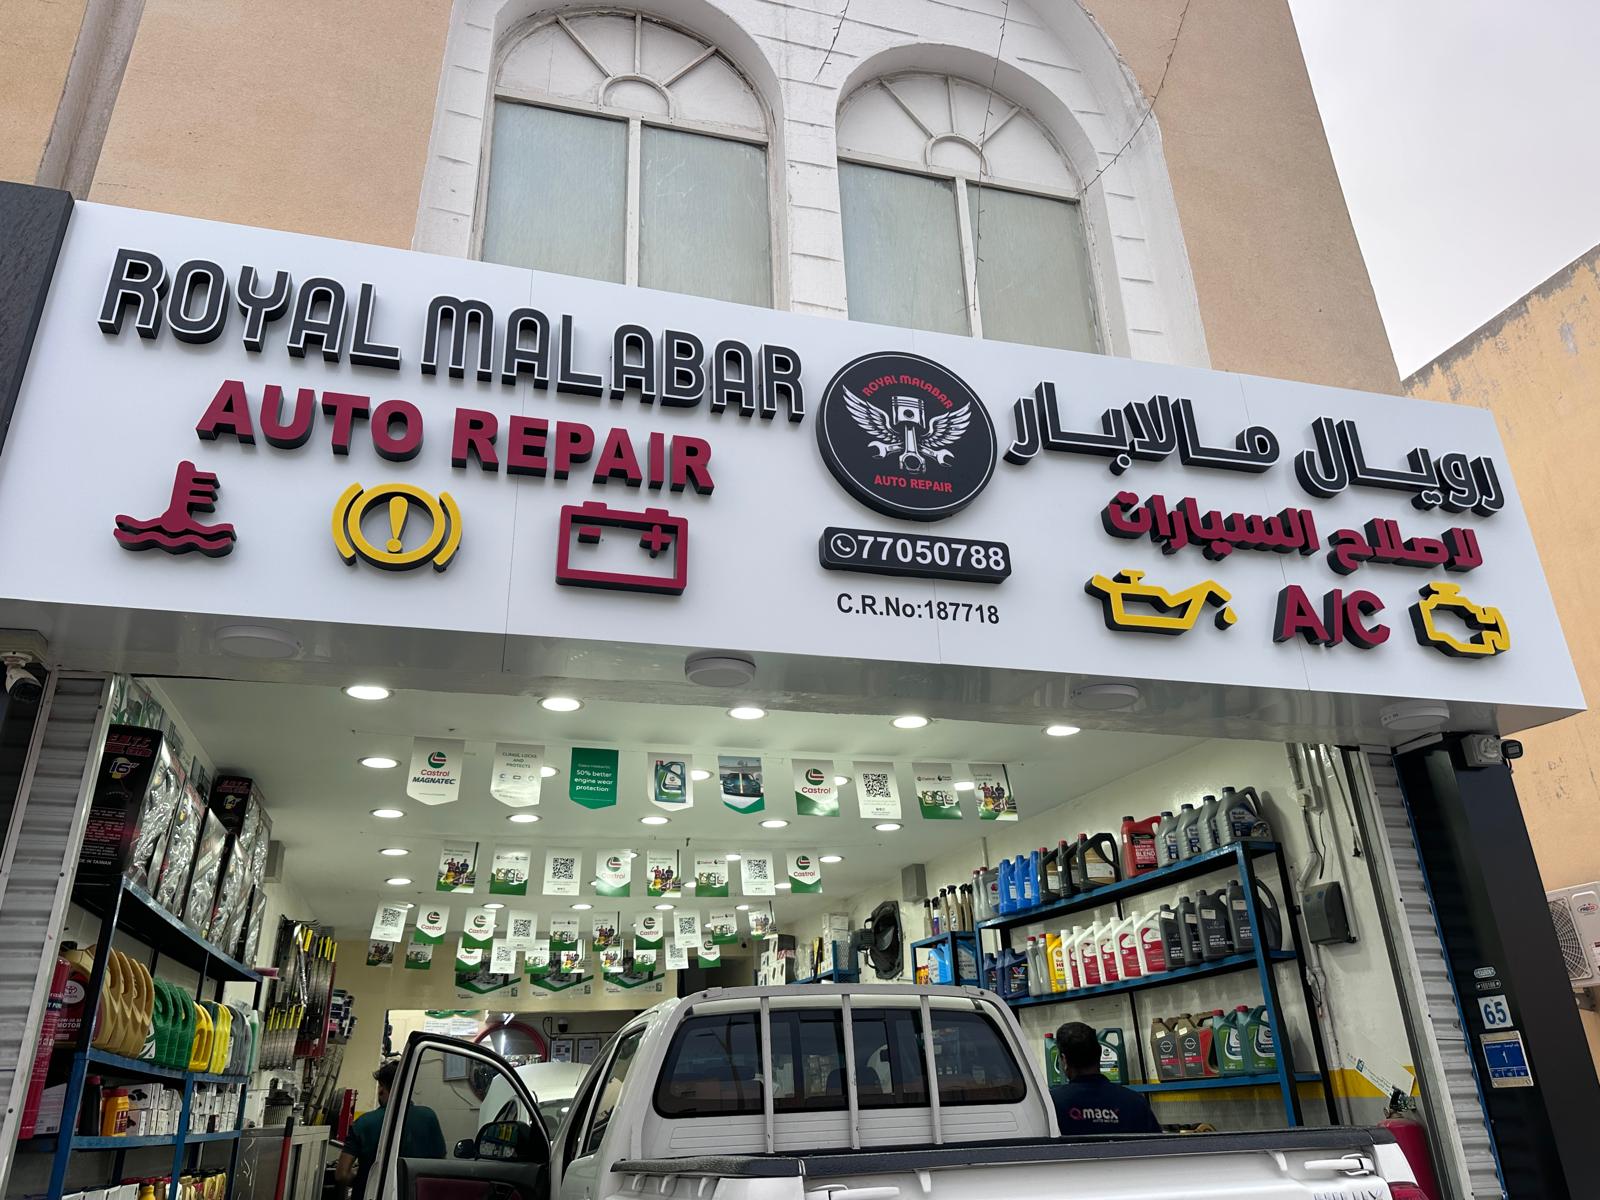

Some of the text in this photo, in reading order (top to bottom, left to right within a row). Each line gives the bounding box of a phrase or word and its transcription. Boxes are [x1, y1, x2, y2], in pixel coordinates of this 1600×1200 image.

[98, 246, 805, 423] ROYAL MALABAR
[862, 375, 954, 409] ROYAL MALABAR
[196, 379, 715, 496] AUTO REPAIR
[873, 474, 953, 493] AUTO REPAIR
[1100, 490, 1321, 562] السيارات
[857, 535, 1006, 571] 77050788
[836, 592, 1000, 624] C.R.No:187718
[412, 776, 457, 785] MAGNATEC
[420, 769, 450, 777] Castrol
[574, 777, 597, 785] engine
[592, 770, 612, 778] better
[801, 786, 831, 795] Castrol
[420, 924, 442, 932] Castrol
[1483, 1001, 1507, 1025] 65
